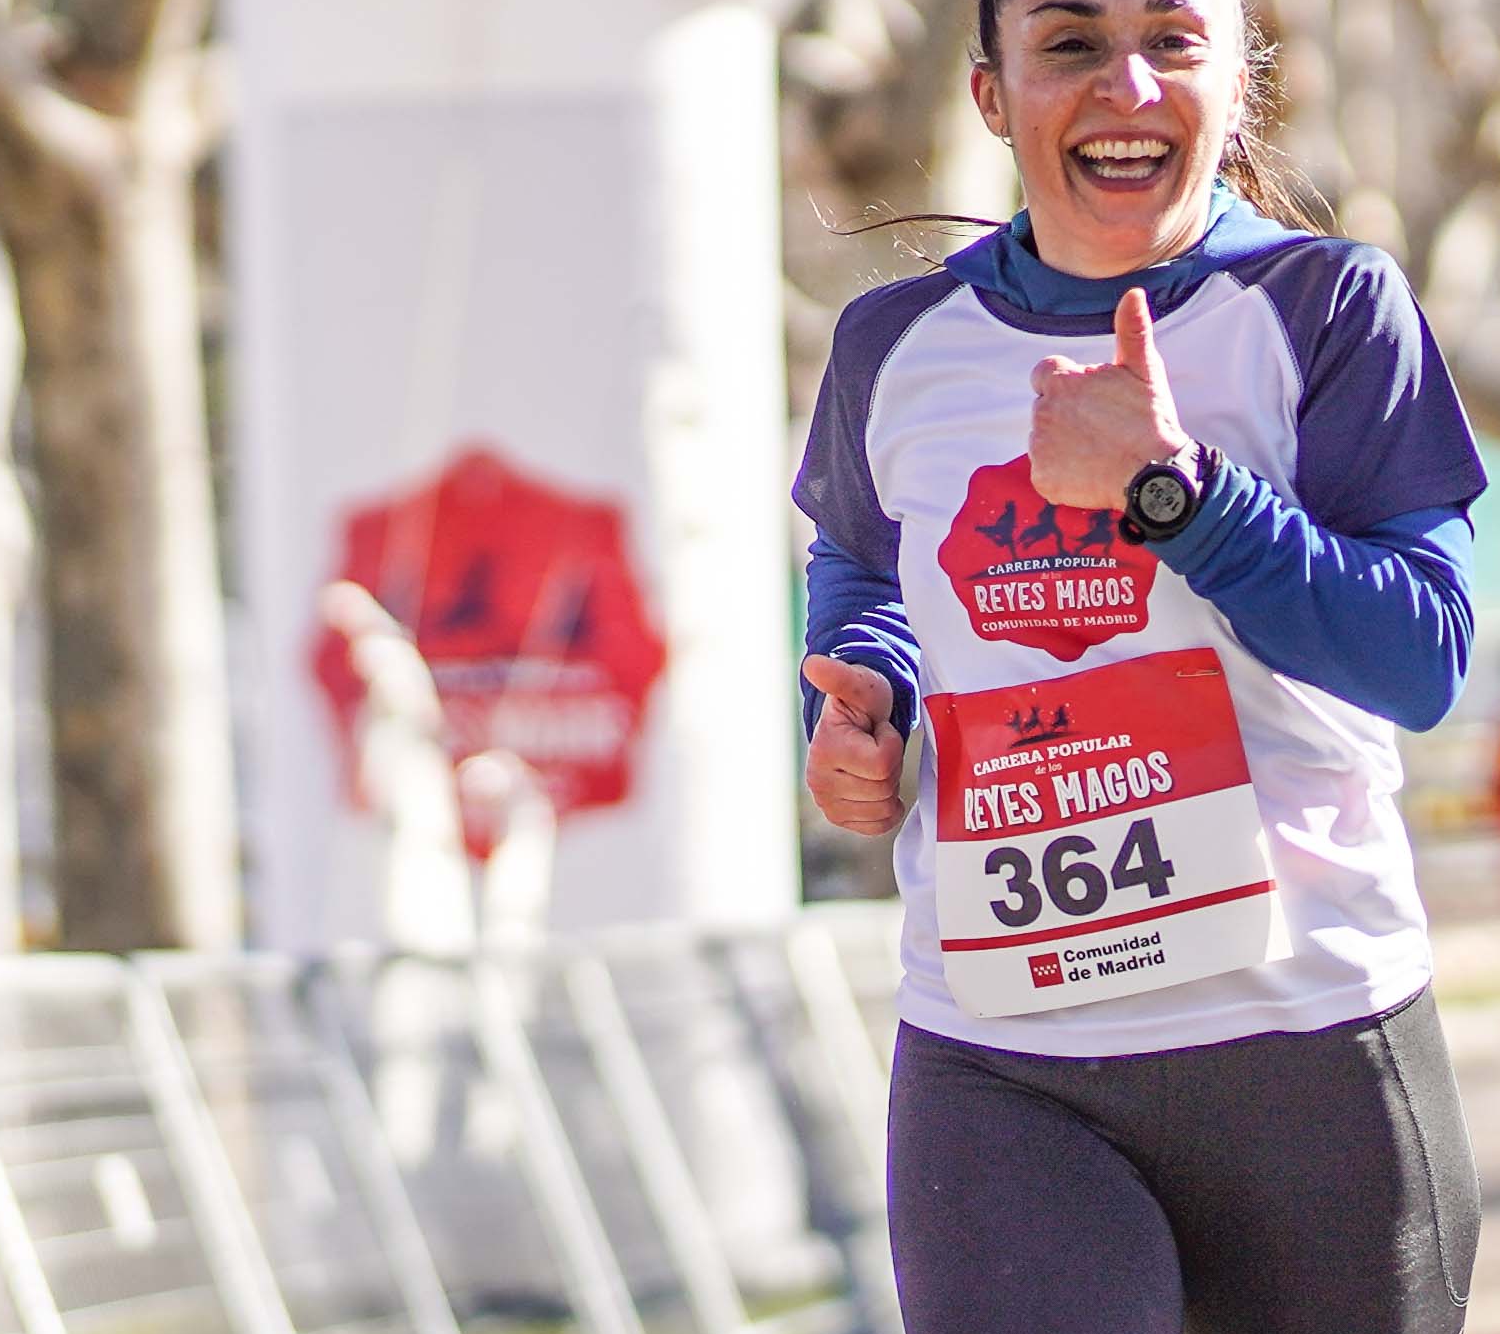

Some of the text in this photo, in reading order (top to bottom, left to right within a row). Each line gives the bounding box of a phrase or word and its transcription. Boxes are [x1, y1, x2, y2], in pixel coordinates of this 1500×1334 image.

[987, 557, 1117, 575] CARRERA POPULAR
[974, 576, 1136, 614] REYES MAGOS
[982, 614, 1138, 632] COMUNIDAD DE MADRID
[973, 734, 1132, 776] CARRERA POPULAR
[1034, 763, 1062, 775] de los
[964, 751, 1173, 832] REYES MAGOS
[984, 817, 1175, 927] 364
[1063, 931, 1161, 963] Comunidad
[1068, 950, 1165, 982] de Madrid
